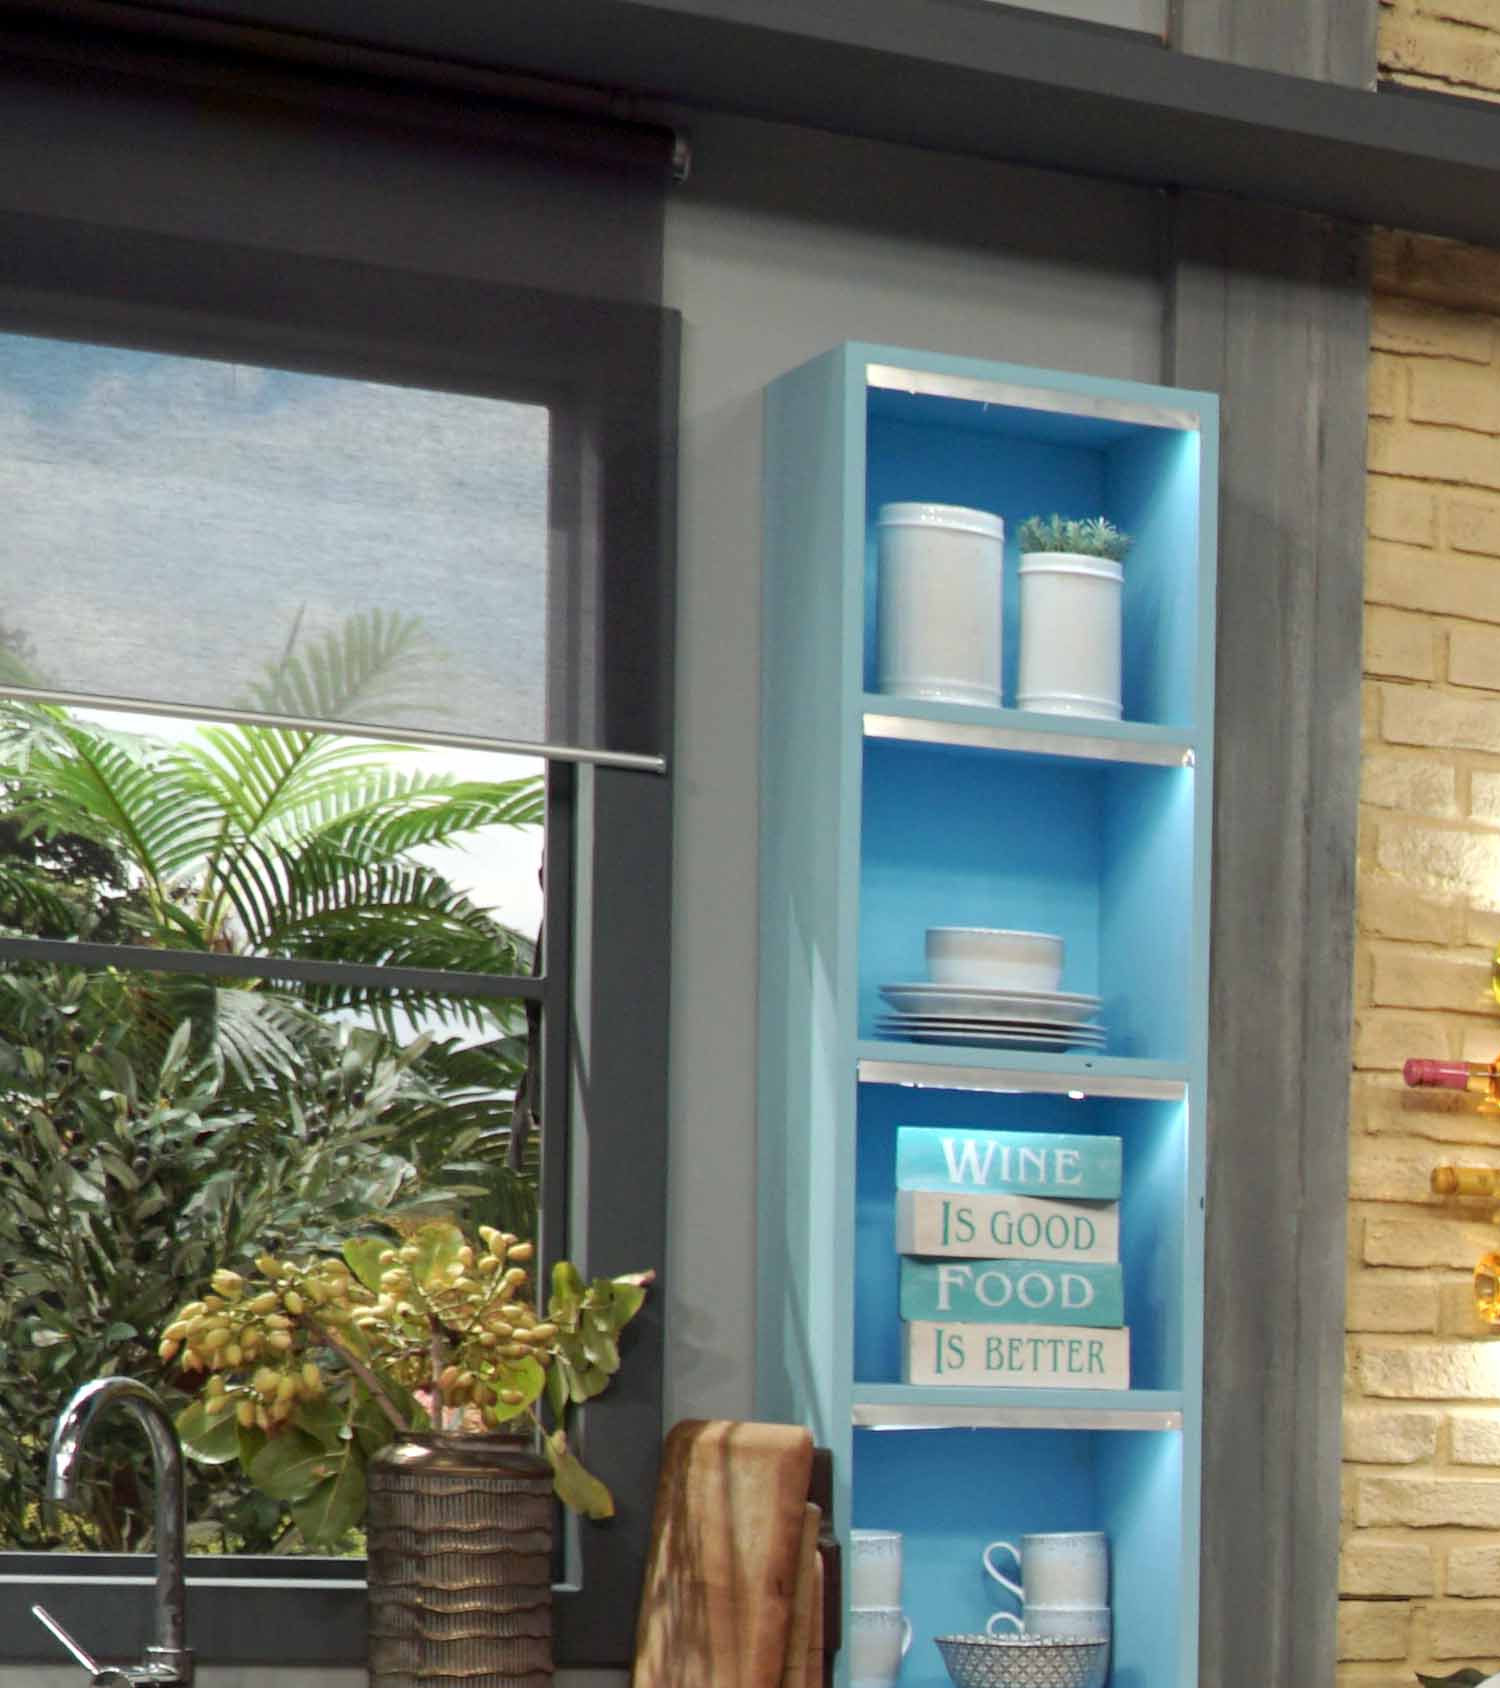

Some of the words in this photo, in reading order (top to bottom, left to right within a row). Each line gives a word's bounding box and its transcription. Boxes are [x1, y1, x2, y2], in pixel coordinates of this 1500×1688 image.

[942, 1137, 1083, 1186] WINE
[941, 1201, 976, 1247] IS
[990, 1211, 1096, 1251] GOOD
[936, 1265, 1095, 1312] FOOD
[935, 1329, 966, 1375] IS
[985, 1337, 1105, 1375] BETTER
